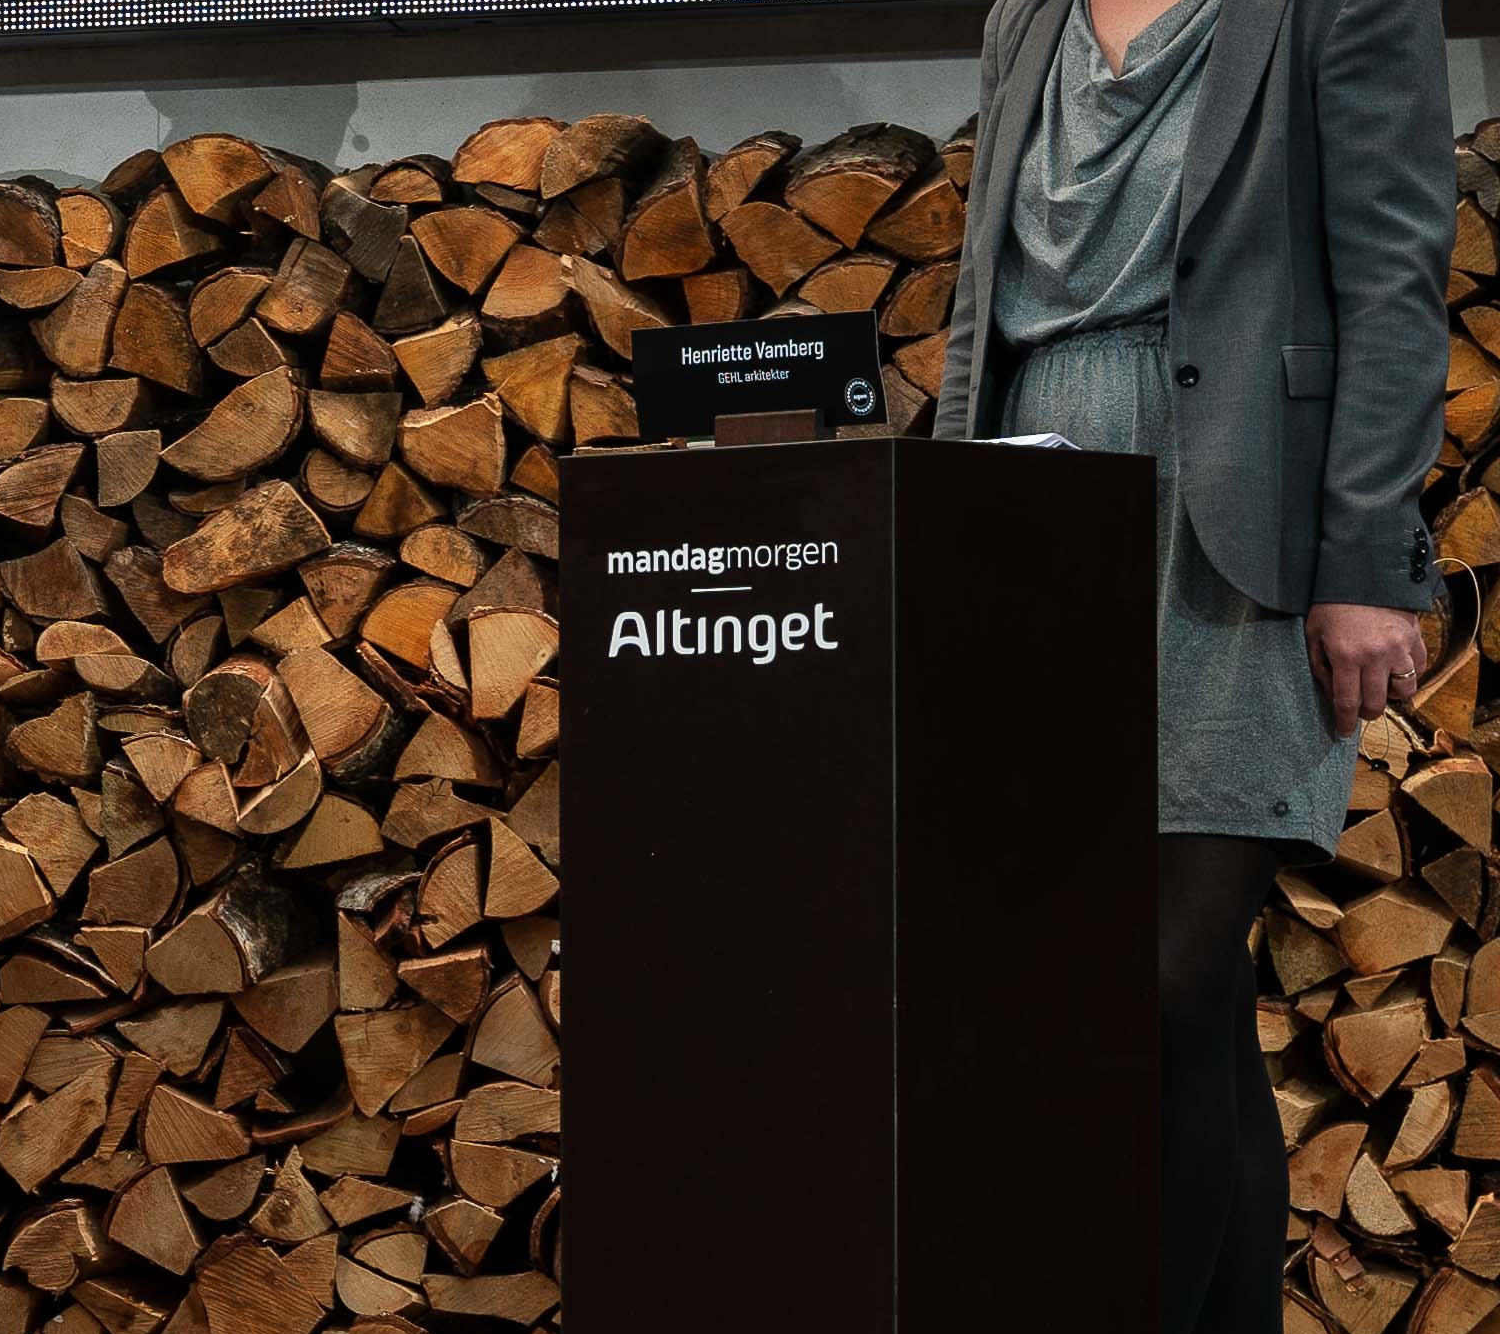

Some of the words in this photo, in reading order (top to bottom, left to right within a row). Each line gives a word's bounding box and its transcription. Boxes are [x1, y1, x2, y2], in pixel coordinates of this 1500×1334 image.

[681, 345, 752, 366] Henriette
[755, 339, 825, 360] Vamberg
[718, 372, 743, 385] GEHL
[744, 369, 790, 383] arkitekter
[607, 540, 838, 575] mandagmorgen
[608, 602, 839, 666] Altinget
